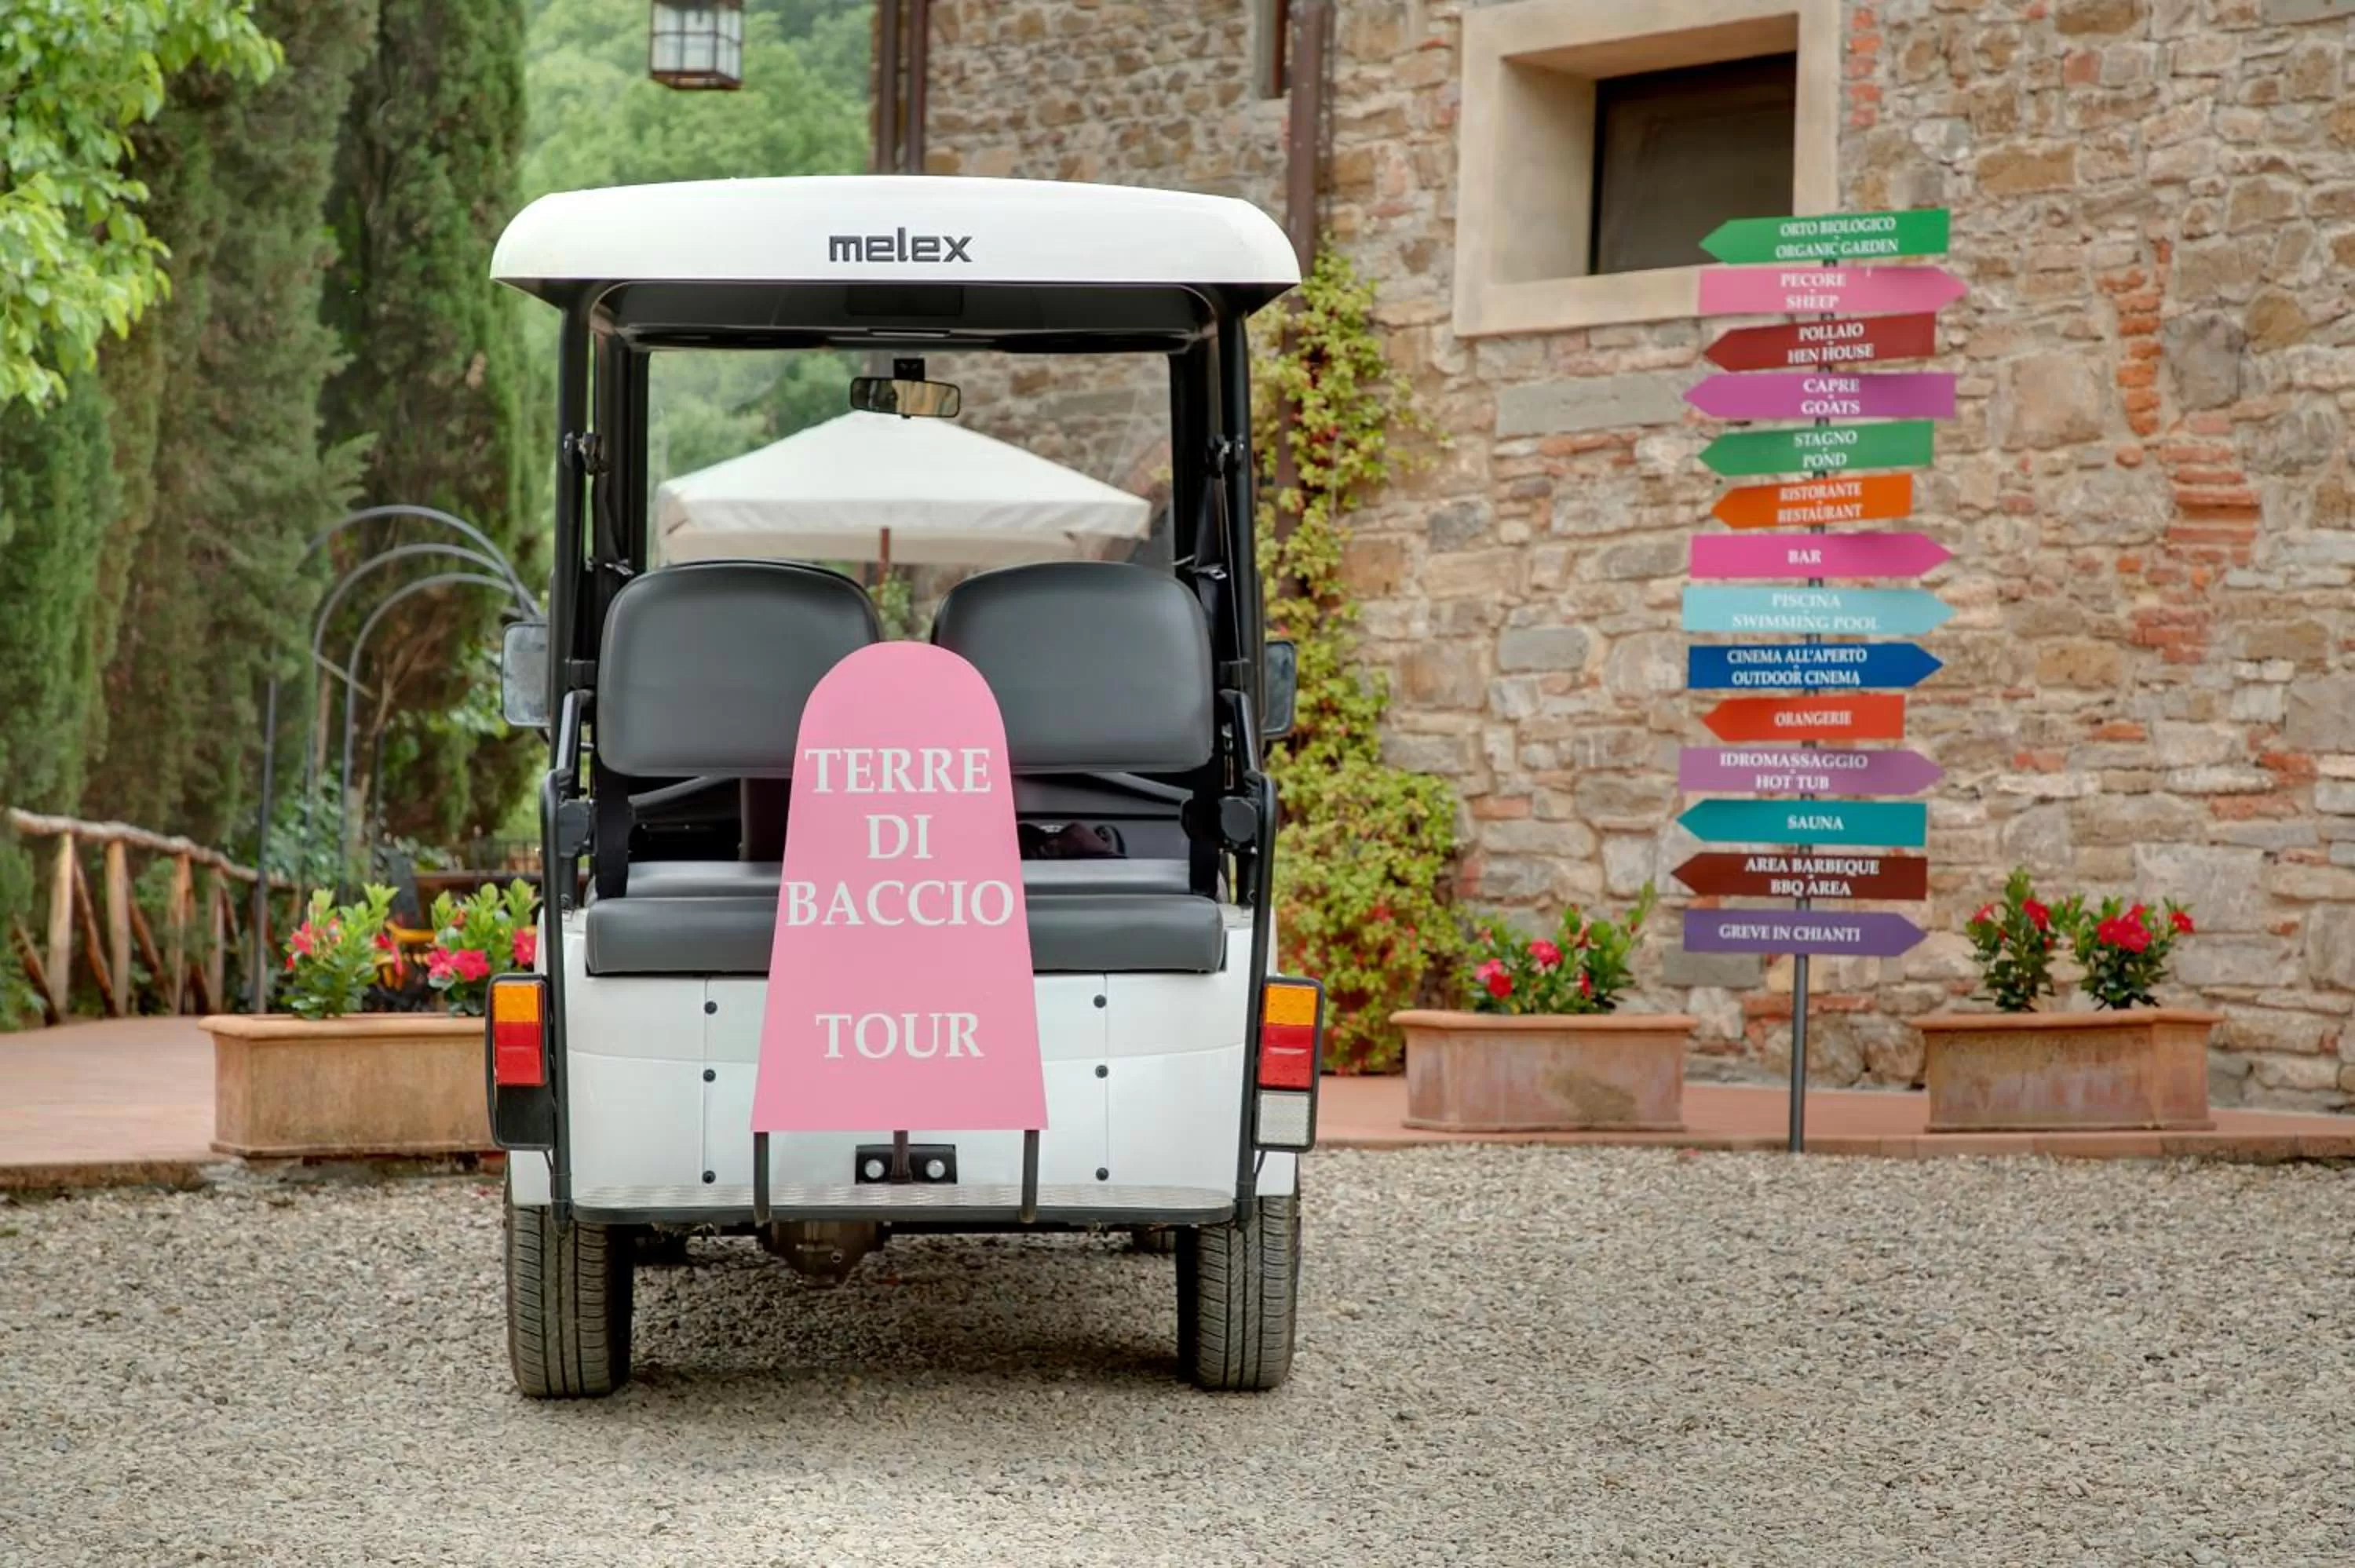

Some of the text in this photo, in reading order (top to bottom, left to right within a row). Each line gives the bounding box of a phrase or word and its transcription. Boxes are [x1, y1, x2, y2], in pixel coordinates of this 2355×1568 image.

[1780, 217, 1896, 235] ORTO BIOLOGICO
[830, 227, 973, 262] melex
[1776, 239, 1898, 258] ORGANIC GARDEN
[1780, 274, 1846, 286] PECORE
[1787, 296, 1839, 308] SHEEP
[1799, 323, 1864, 340] POLLAIO
[1787, 345, 1874, 364] HEN HOUSE
[1803, 379, 1859, 392] CAPRE
[1801, 400, 1860, 414] GOATS
[1794, 430, 1857, 447] STAGNO
[1803, 453, 1846, 468] POND
[1788, 550, 1820, 563] BAR
[1773, 594, 1840, 607] PISCINA
[1733, 615, 1879, 629] SWIMMING POOL
[1728, 649, 1867, 663] CINEMA ALL'APERTO
[1732, 672, 1860, 686] OUTDOOR CINEMA
[1775, 711, 1852, 726] ORANGERIE
[1720, 753, 1868, 768] IDROMASSAGGIO
[805, 748, 991, 793] TERRE
[1756, 775, 1829, 789] HOT TUB
[1787, 815, 1843, 830] SAUNA
[867, 815, 933, 859] DI
[1745, 858, 1879, 877] AREA BARBEQUE
[1771, 880, 1851, 896] BBQ AREA
[785, 880, 1014, 926] BACCIO
[1719, 924, 1860, 942] GREVE IN CHIANTI
[816, 1013, 984, 1058] TOUR
